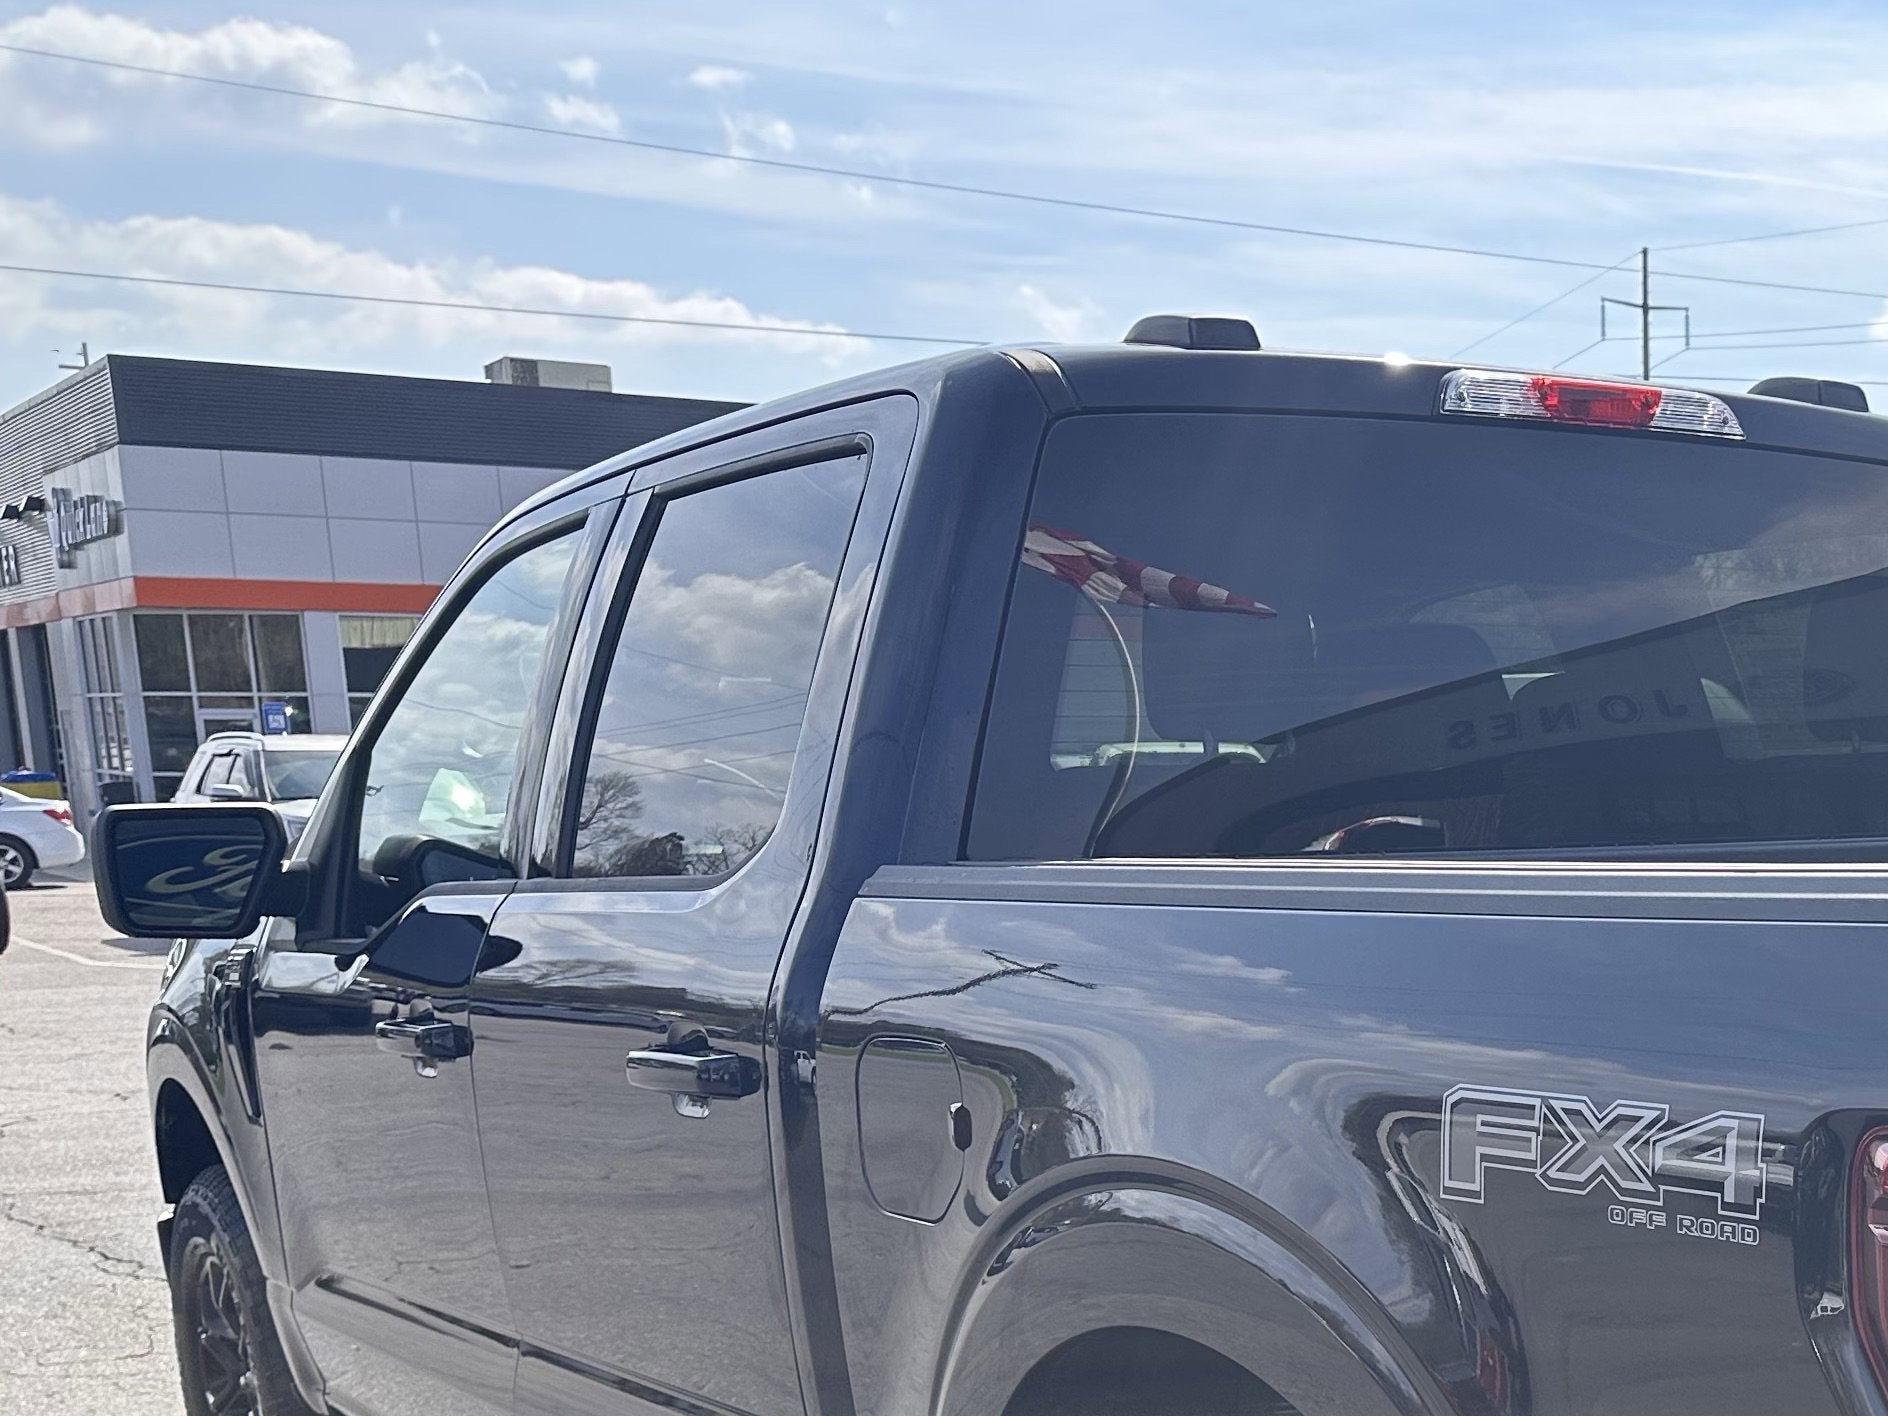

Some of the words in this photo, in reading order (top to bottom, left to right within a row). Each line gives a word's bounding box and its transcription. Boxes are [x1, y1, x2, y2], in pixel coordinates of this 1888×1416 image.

[1440, 1083, 1766, 1220] FX4
[1608, 1205, 1667, 1230] OFF
[1676, 1215, 1760, 1246] ROAD
